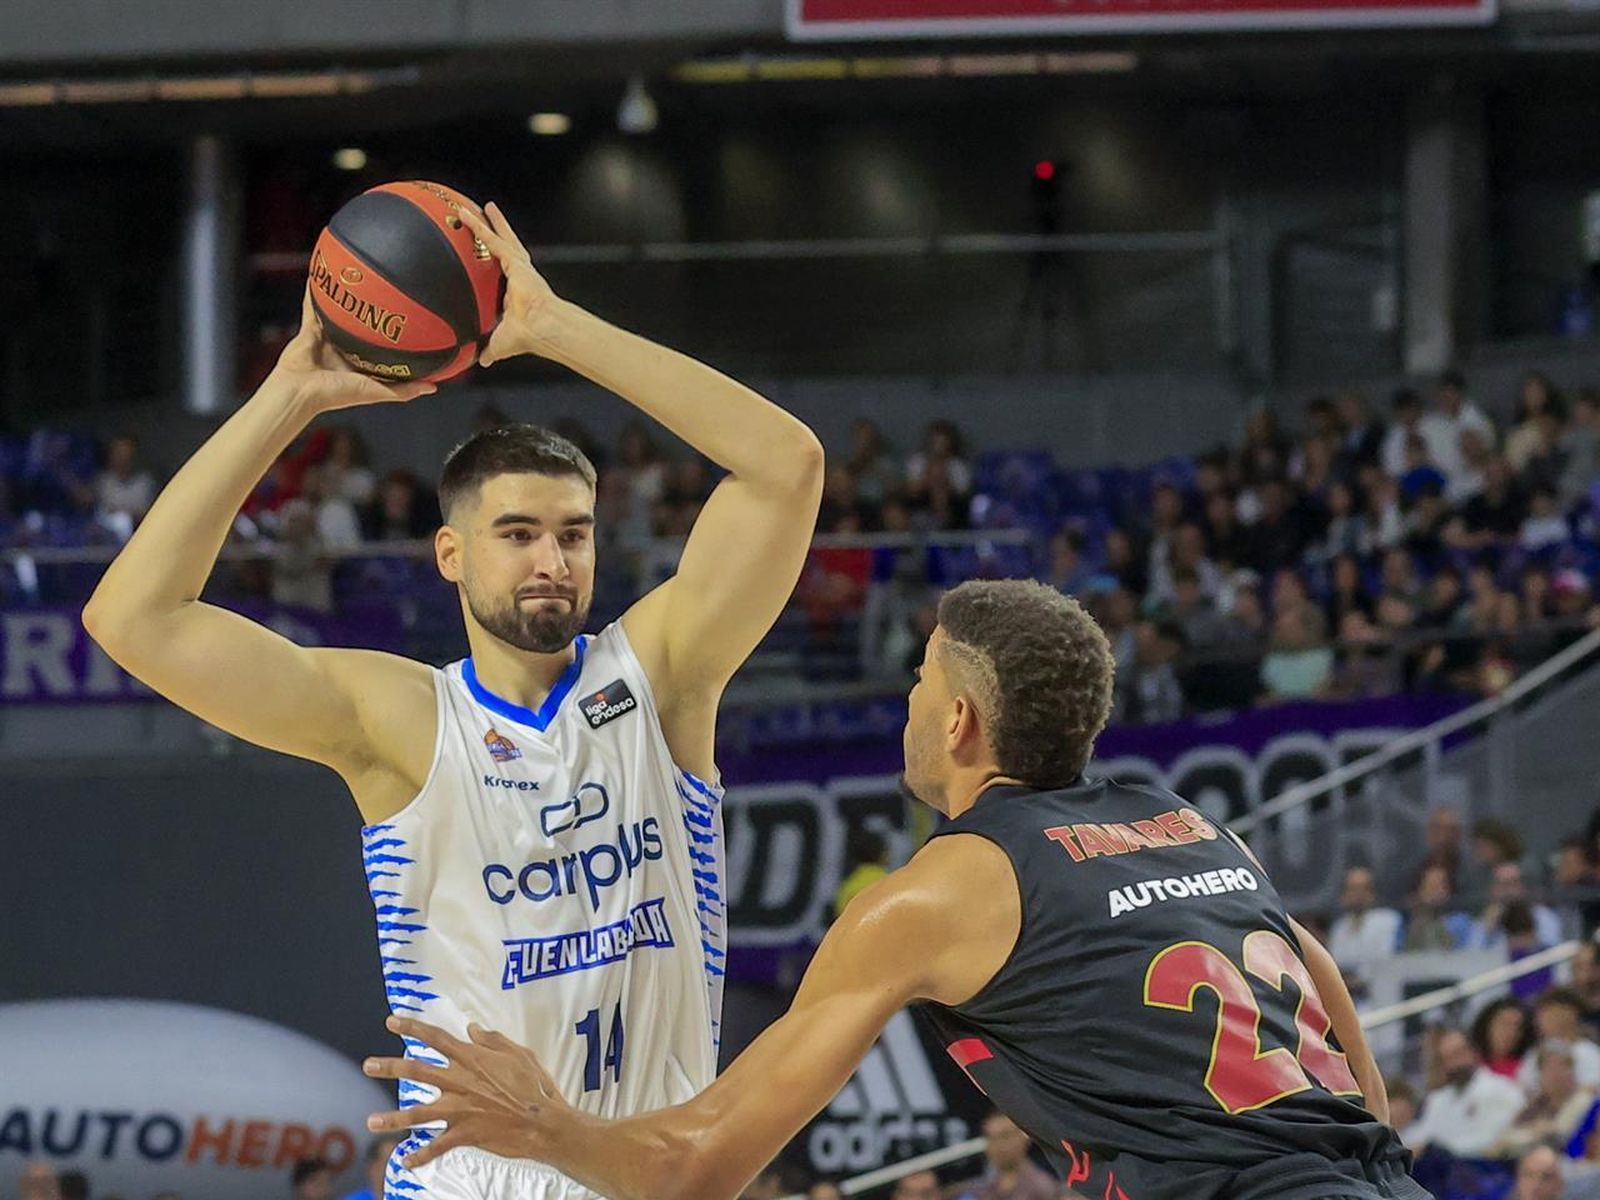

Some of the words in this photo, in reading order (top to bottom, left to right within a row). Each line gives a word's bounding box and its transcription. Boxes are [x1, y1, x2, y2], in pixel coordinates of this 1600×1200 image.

[585, 700, 608, 717] liga
[592, 697, 635, 725] endesa
[1044, 807, 1218, 862] TAVARES
[1108, 867, 1258, 919] AUTOHERO
[575, 995, 625, 1093] 14
[1143, 930, 1364, 1116] 22
[0, 1107, 356, 1175] AUTOHERO
